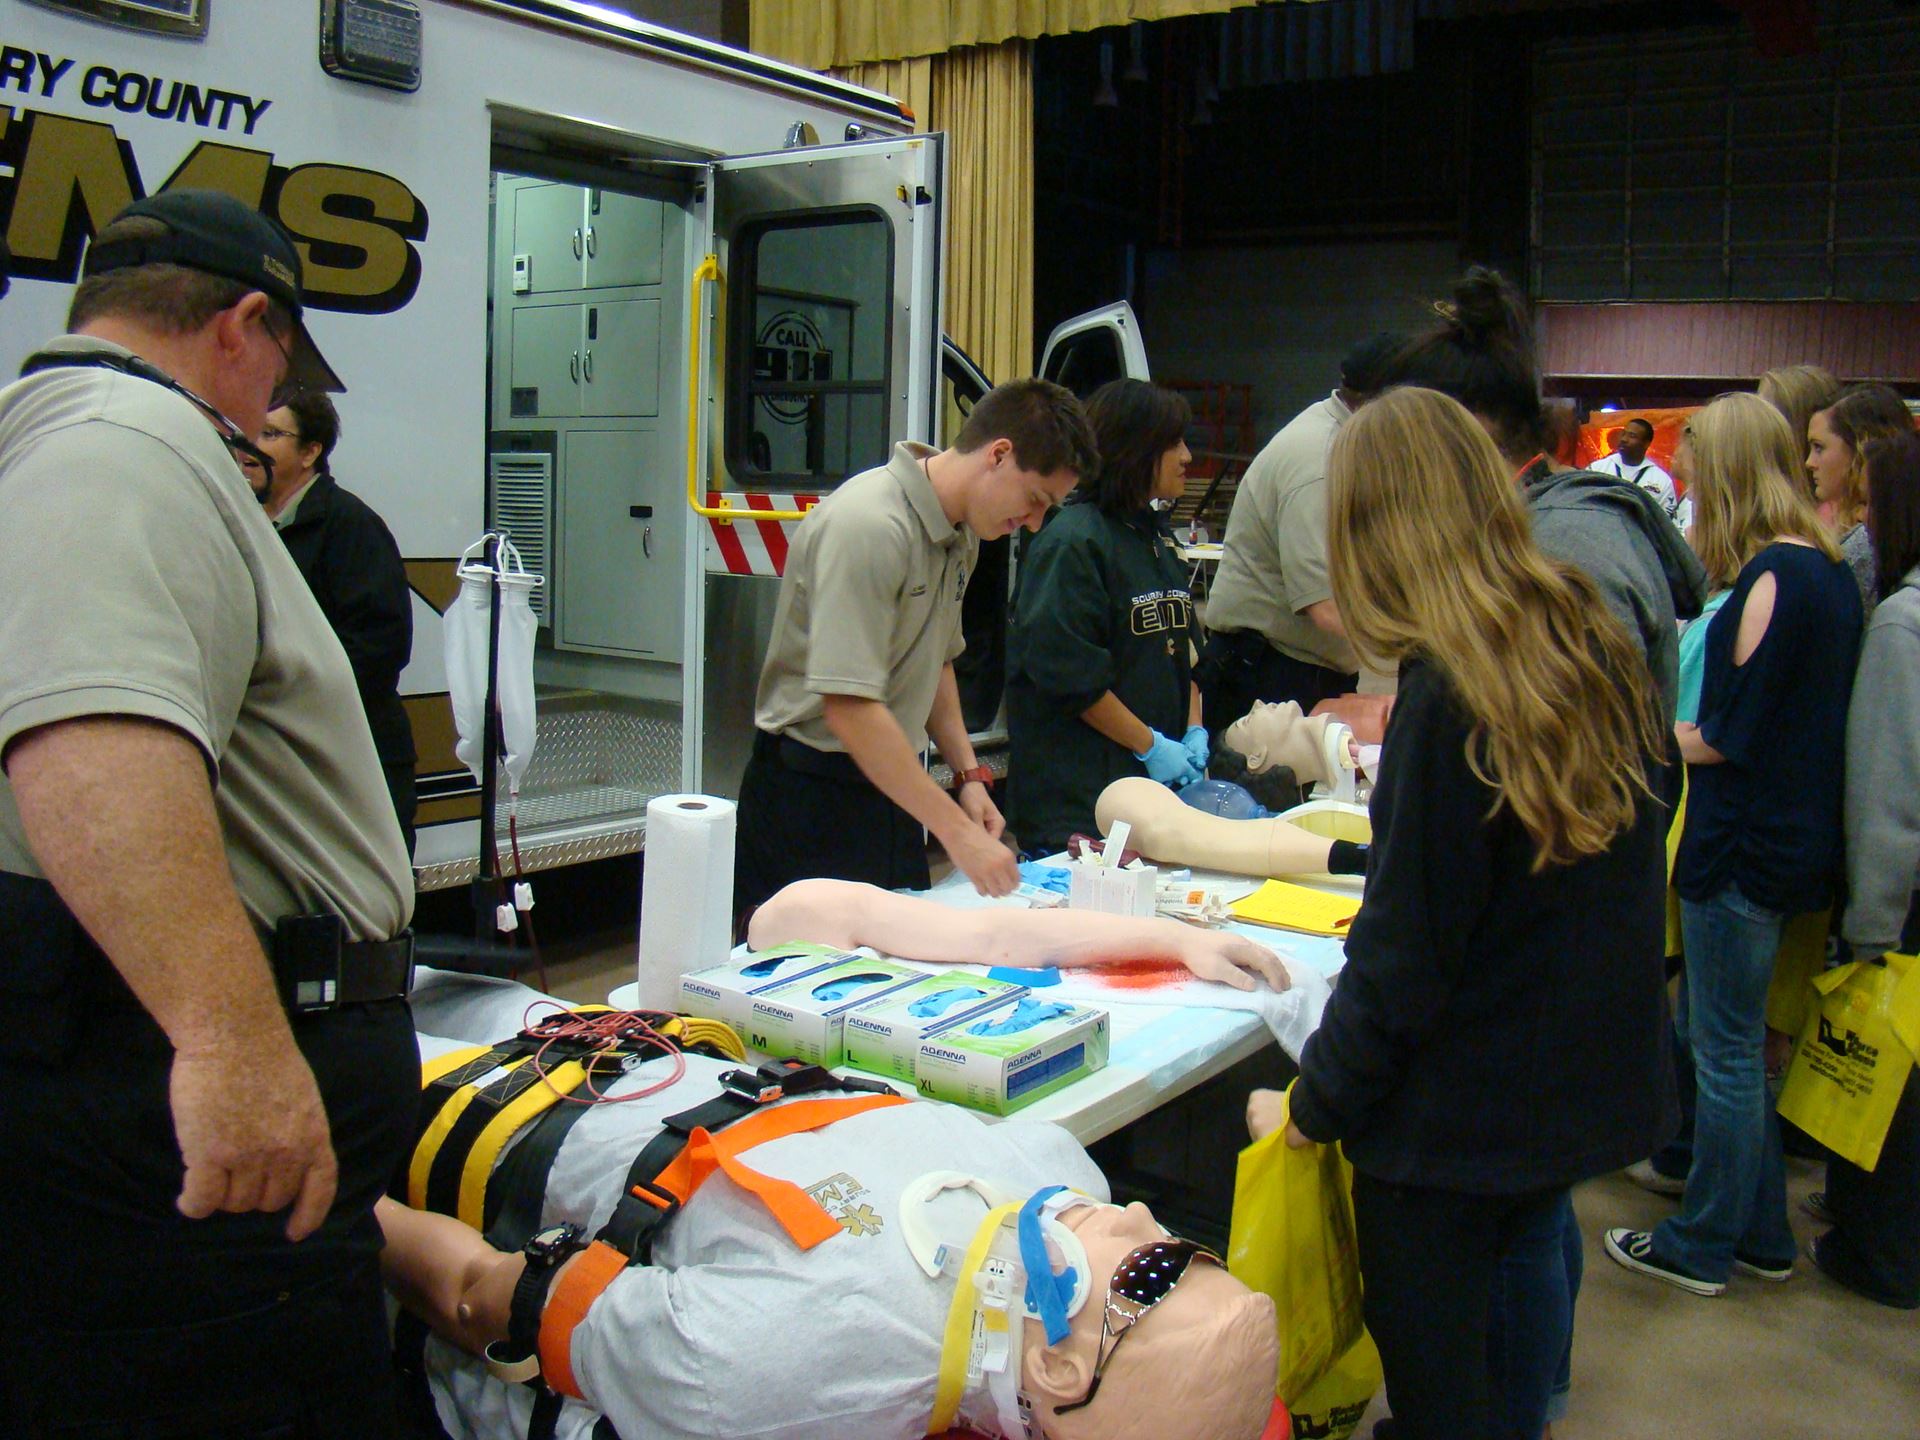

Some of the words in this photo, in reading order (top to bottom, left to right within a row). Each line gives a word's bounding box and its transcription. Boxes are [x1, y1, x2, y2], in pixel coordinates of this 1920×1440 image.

[81, 66, 272, 135] COUNTY
[0, 104, 429, 315] MS
[775, 328, 809, 347] CALL
[682, 982, 721, 999] ADENNA
[753, 1002, 794, 1019] ADENNA
[848, 1017, 892, 1035] ADENNA
[752, 1034, 767, 1048] M
[847, 1050, 858, 1064] L
[920, 1045, 967, 1062] ADENNA
[1007, 1049, 1042, 1069] ADENNA
[920, 1078, 936, 1093] XL
